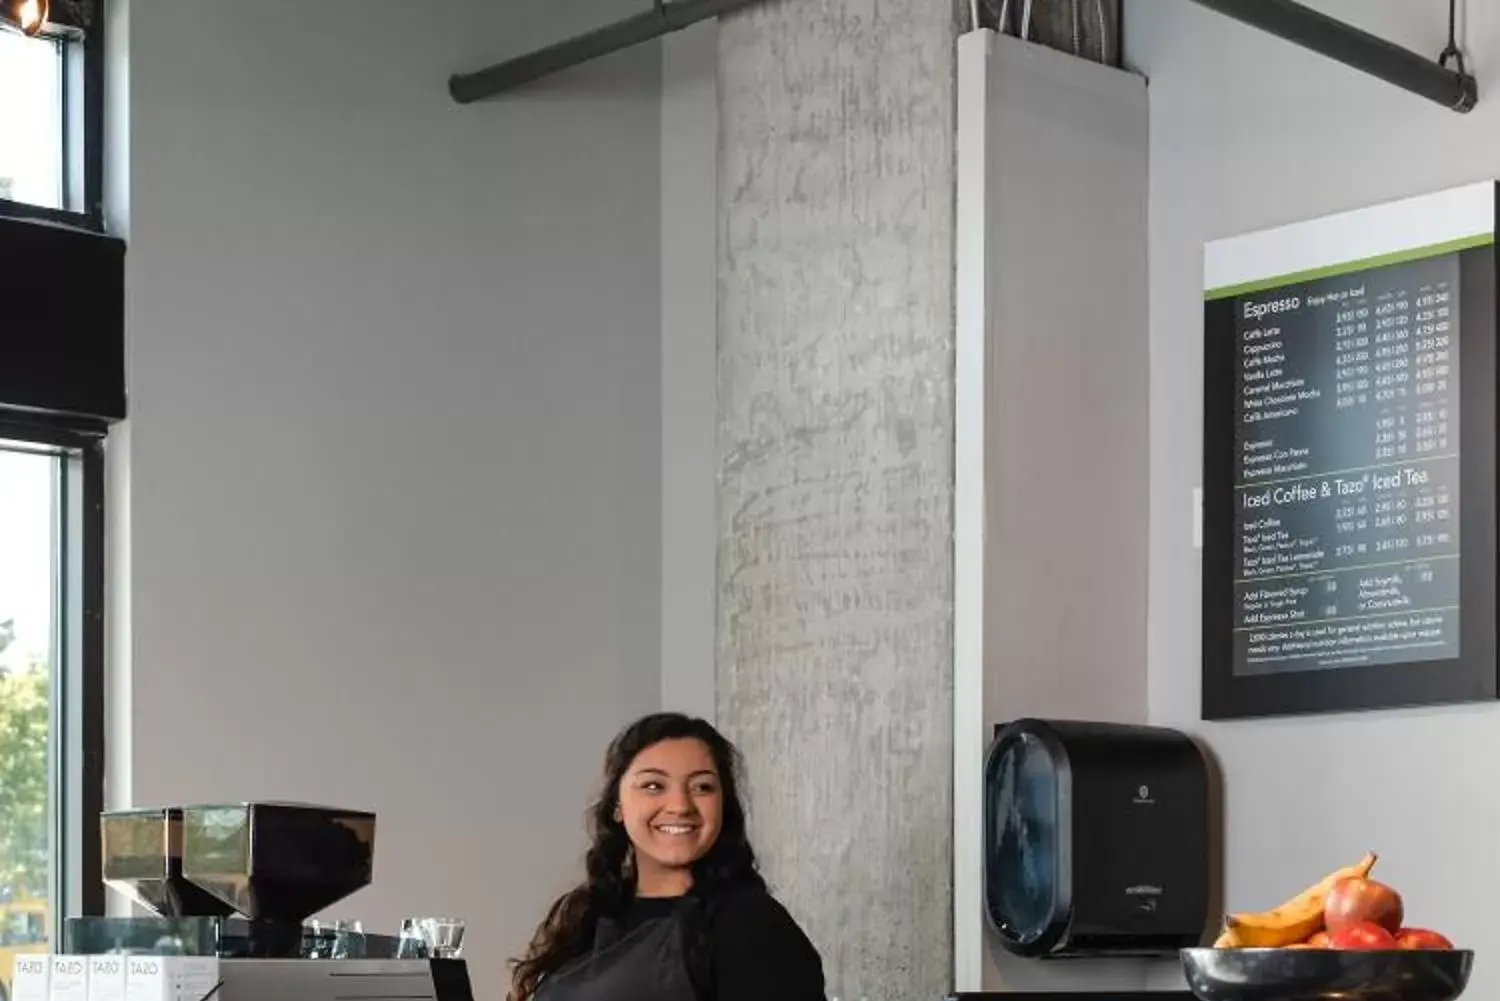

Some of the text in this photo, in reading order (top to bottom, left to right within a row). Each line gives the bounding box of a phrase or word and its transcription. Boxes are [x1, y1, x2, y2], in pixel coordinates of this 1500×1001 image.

[1243, 297, 1300, 320] Espresso
[1243, 489, 1271, 509] Iced
[1273, 484, 1318, 505] Coffee
[1321, 481, 1331, 498] &
[1373, 470, 1402, 491] Iced
[1405, 467, 1430, 486] Tea
